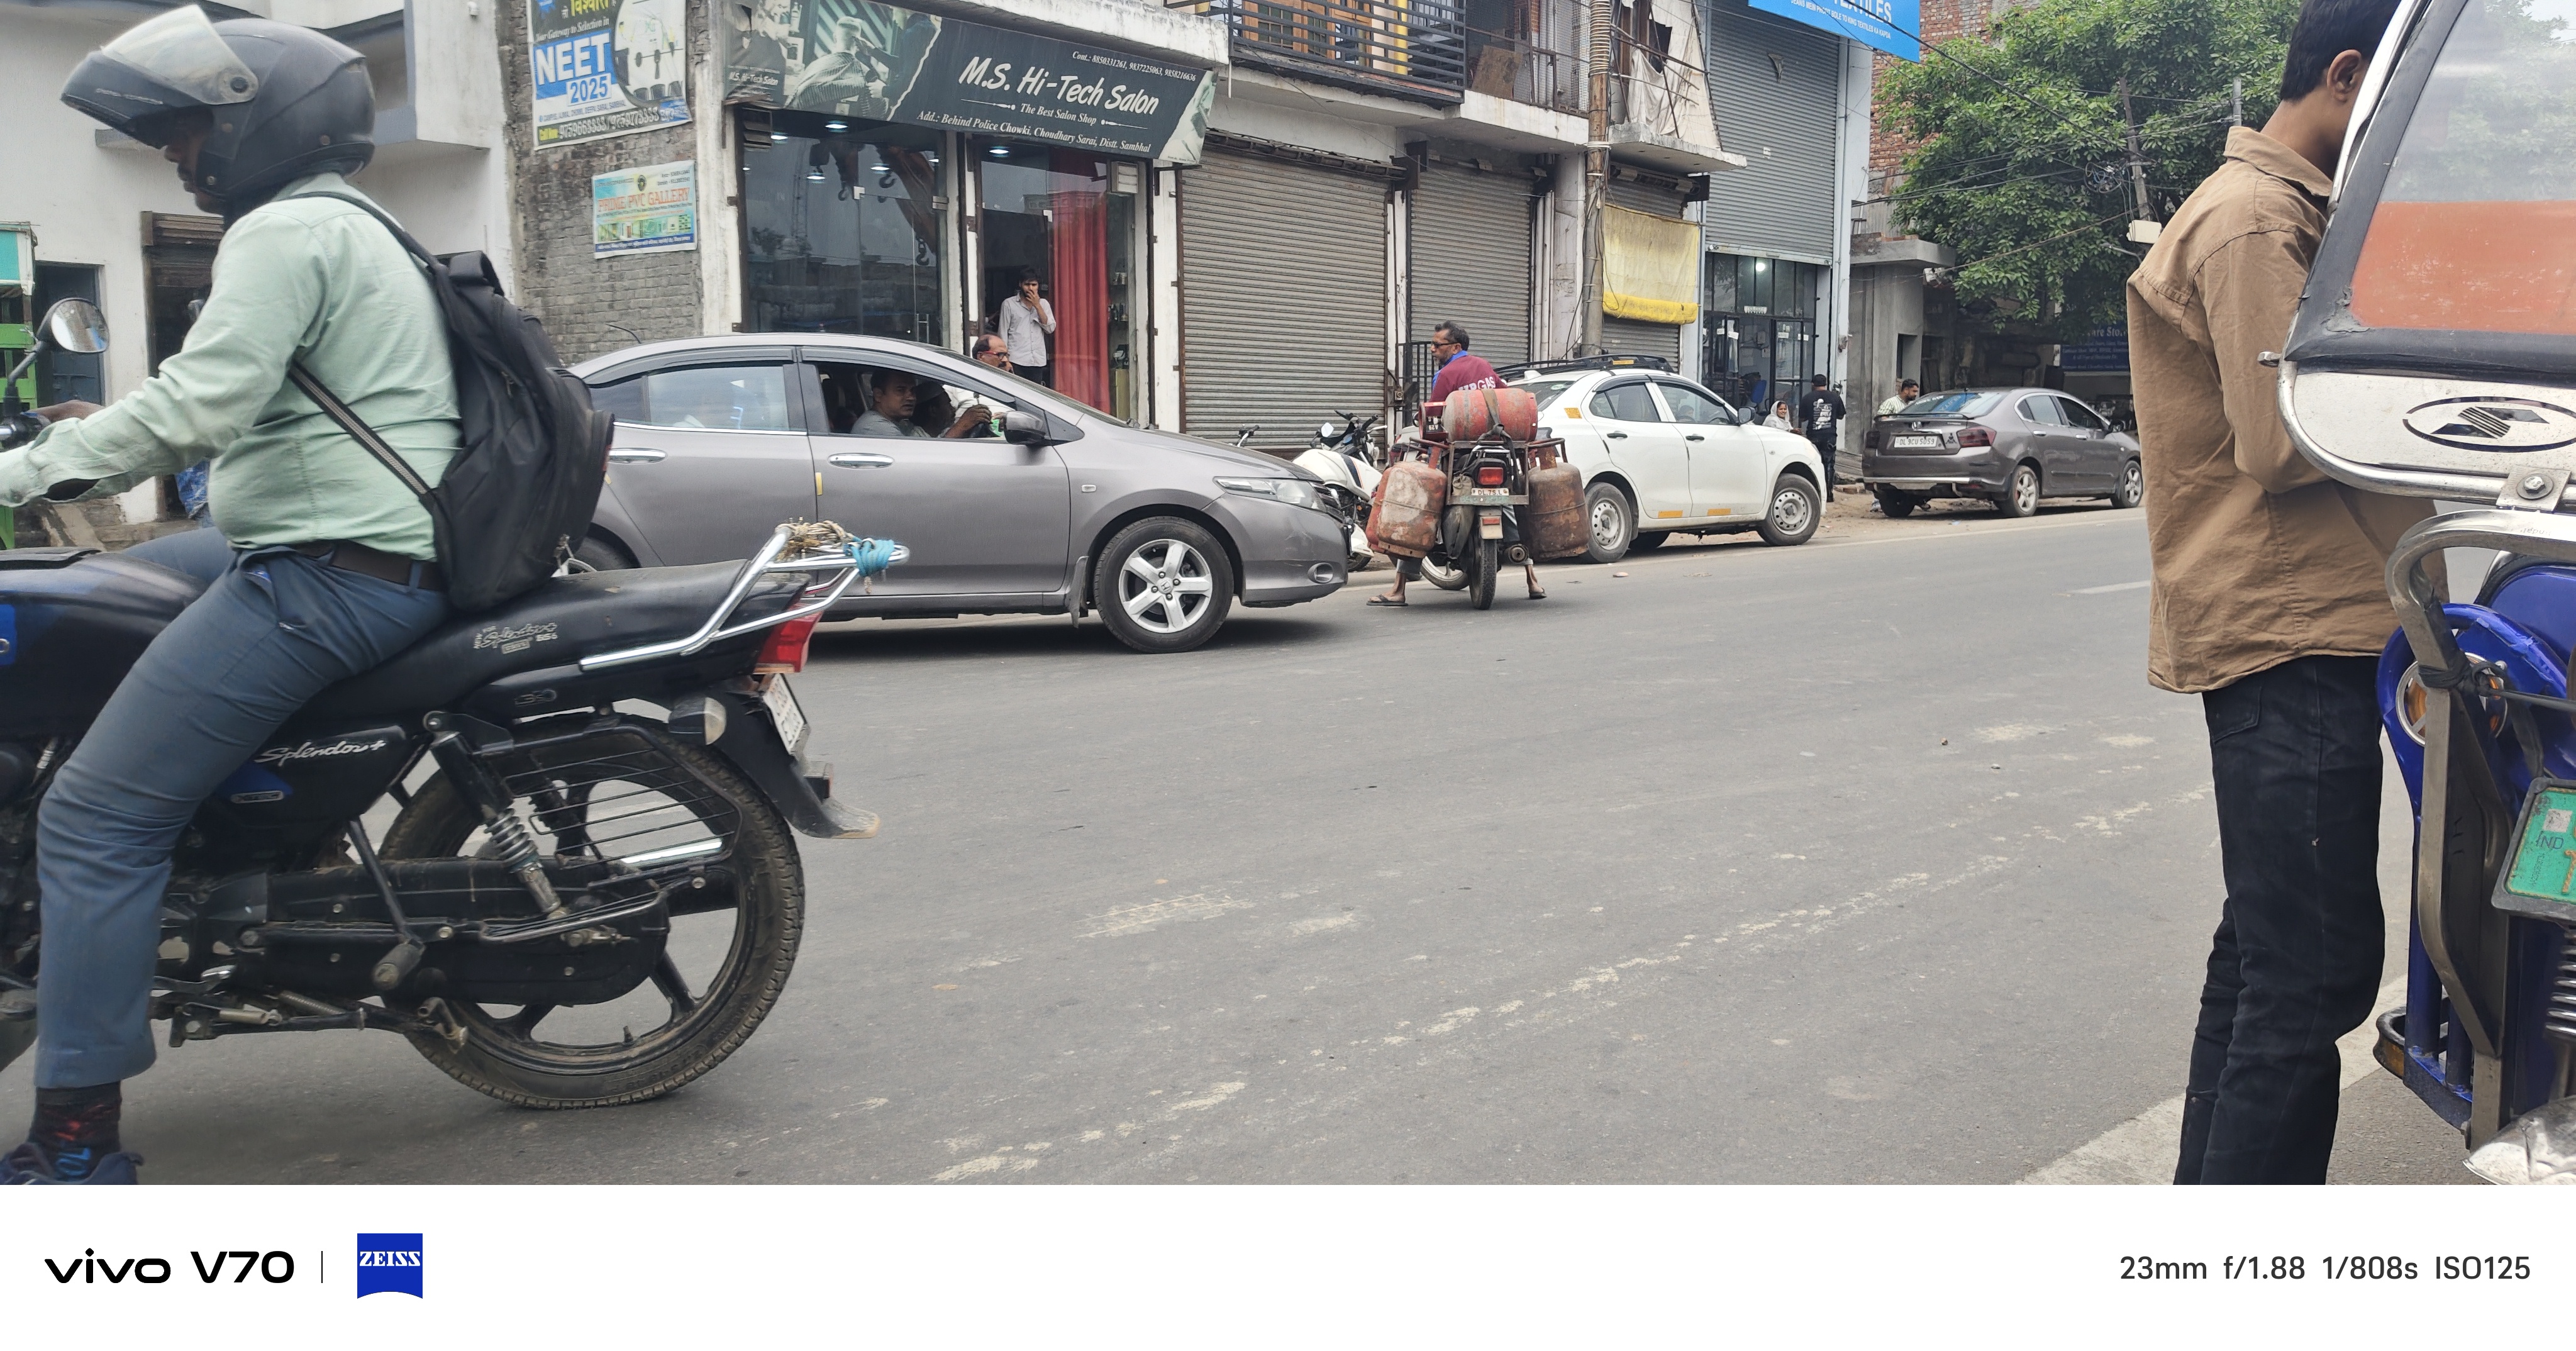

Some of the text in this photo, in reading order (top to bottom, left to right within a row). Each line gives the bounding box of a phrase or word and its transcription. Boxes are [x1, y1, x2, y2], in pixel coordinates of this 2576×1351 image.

[577, 18, 602, 33] Selection
[603, 16, 609, 26] in
[536, 33, 610, 86] NEET
[1092, 55, 1128, 70] 8850331261,
[570, 77, 608, 104] 2025
[958, 56, 1159, 115] M.S. Hi-Tech Salon
[1020, 103, 1097, 126] The Best Salon Shop
[941, 113, 973, 127] Behind
[973, 118, 999, 131] Police
[1000, 122, 1032, 136] Chowki,
[1034, 127, 1076, 145] Choudhary
[1077, 134, 1098, 147] Sarai,
[1099, 137, 1118, 148] Distt.
[1119, 140, 1152, 153] Sambhal
[628, 192, 646, 208] PVC
[648, 187, 690, 205] GALLERY
[2535, 830, 2564, 850] IND
